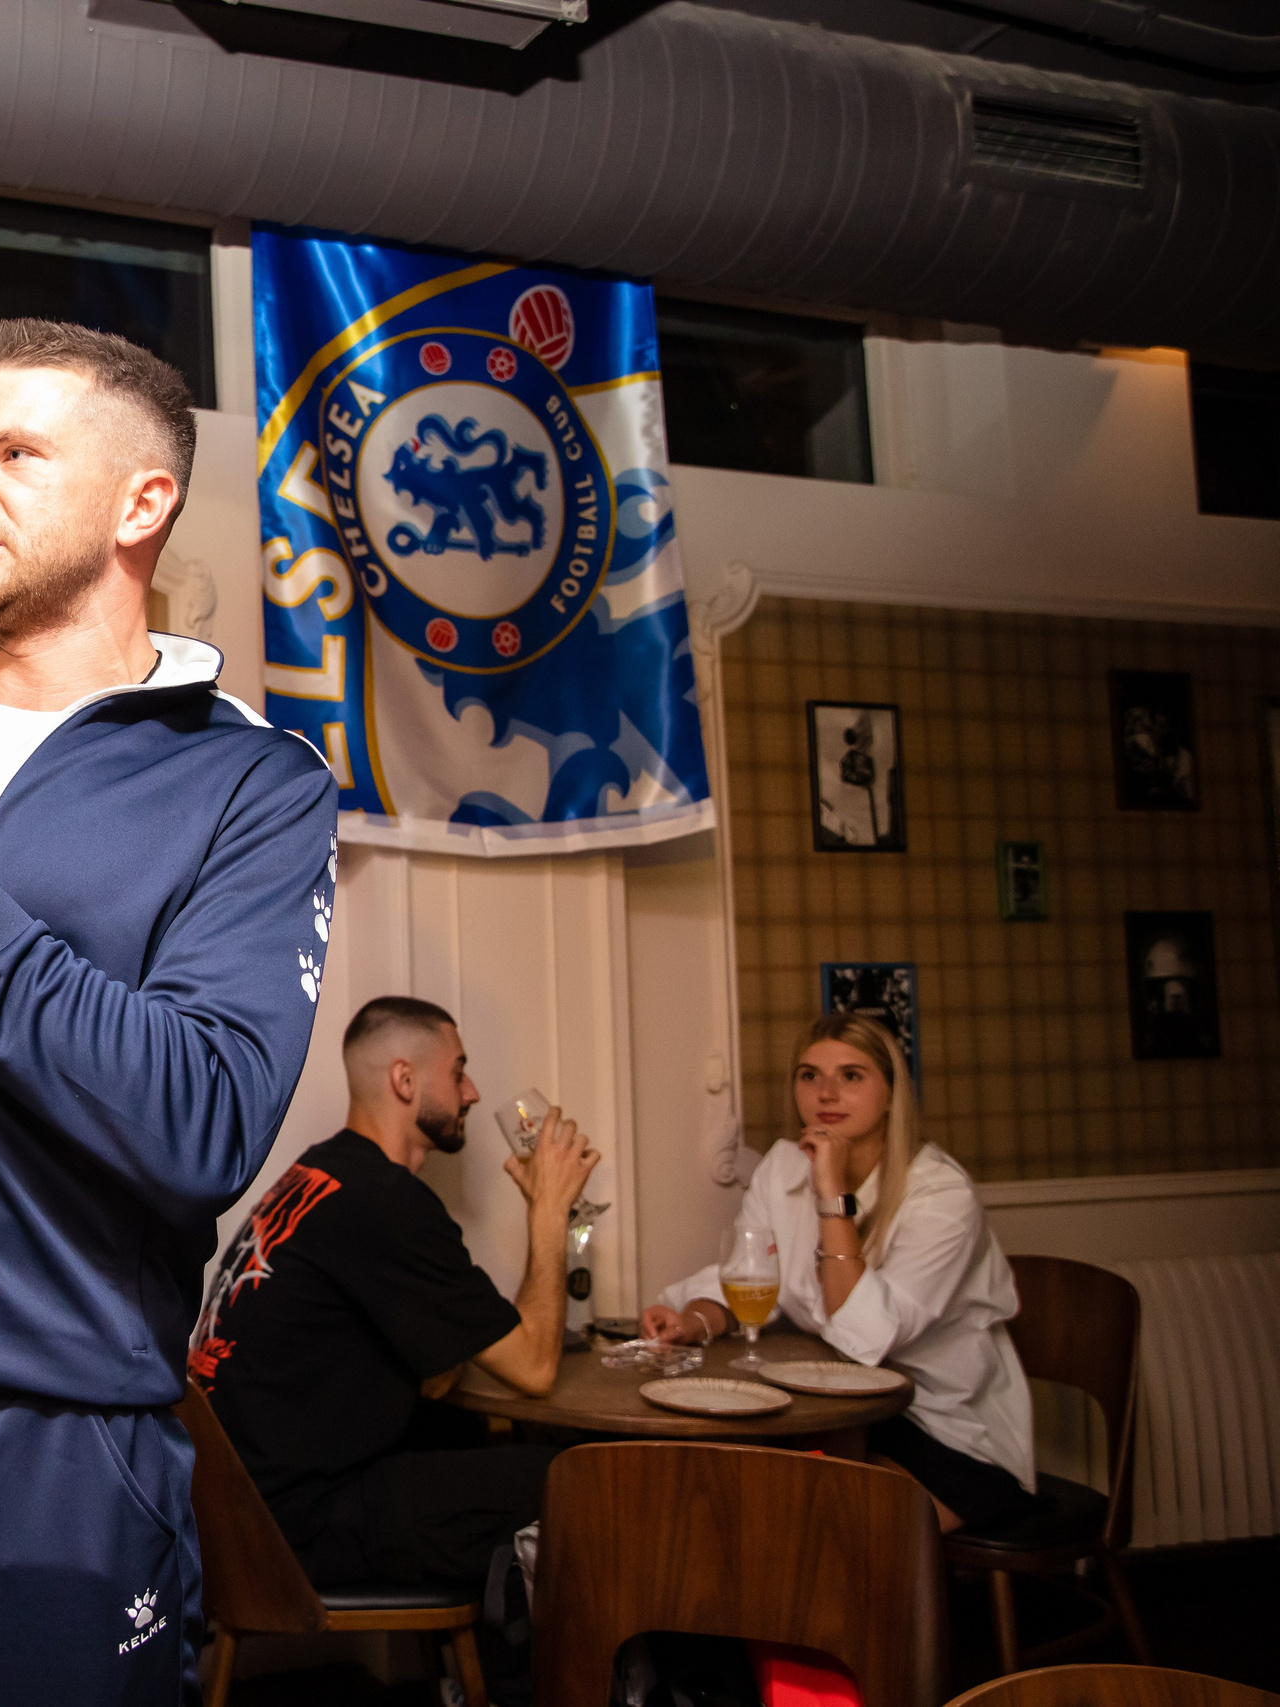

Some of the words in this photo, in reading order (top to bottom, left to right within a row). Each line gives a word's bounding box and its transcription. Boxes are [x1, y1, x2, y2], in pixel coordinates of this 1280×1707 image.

[545, 395, 583, 461] CLUB
[325, 378, 388, 598] CHELSEA
[550, 473, 599, 614] FOOTBALL
[118, 1615, 168, 1655] KELME
